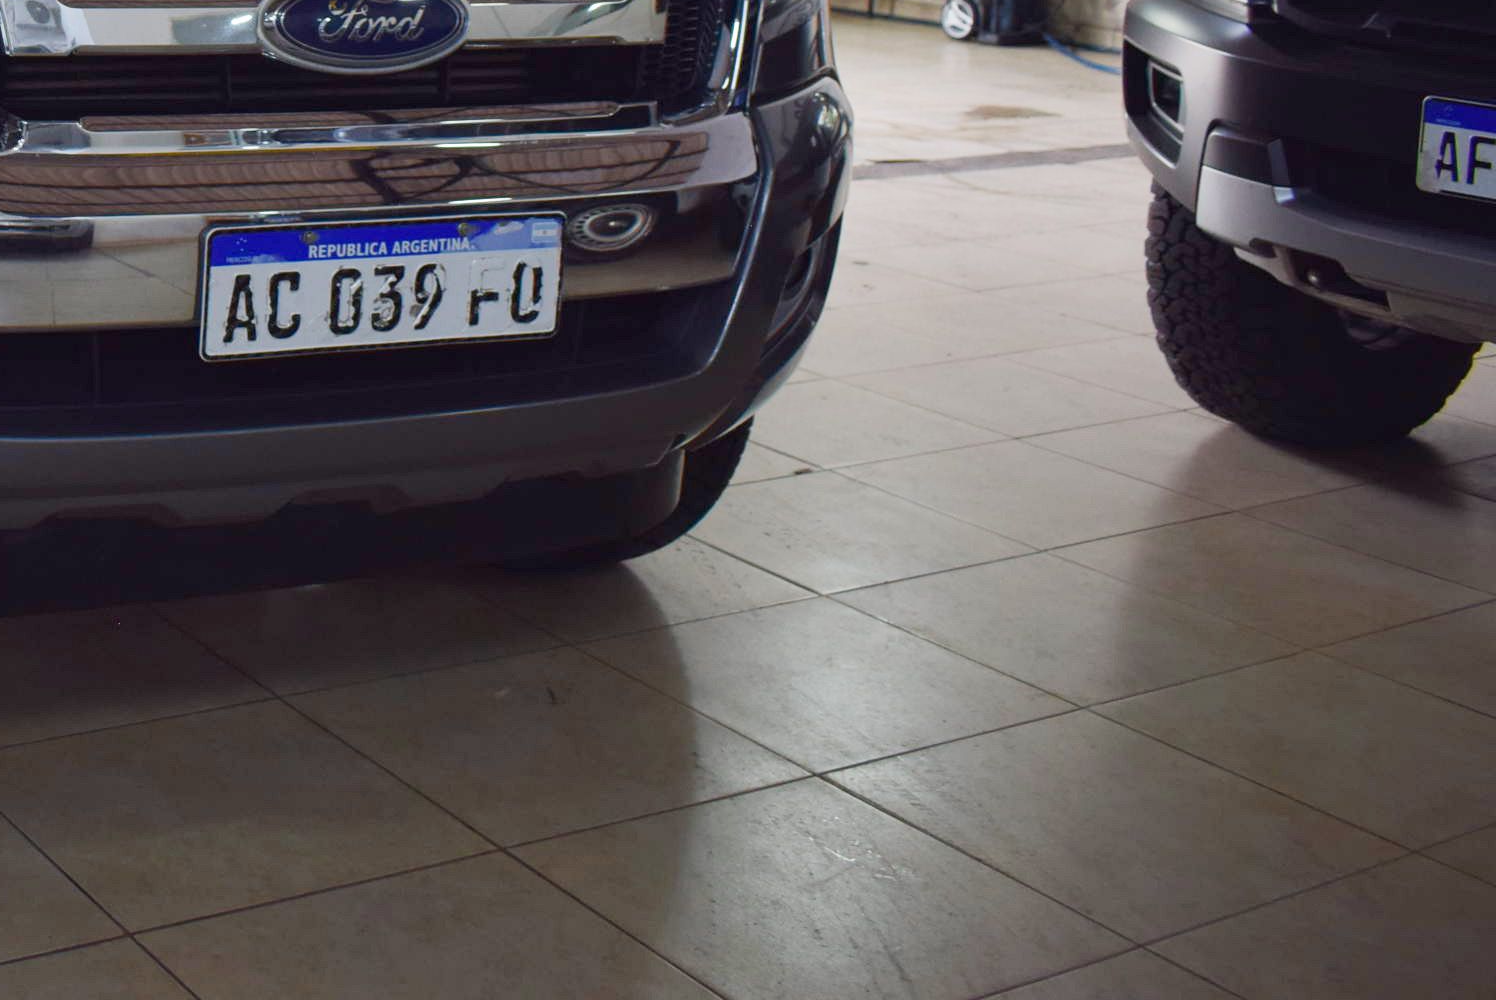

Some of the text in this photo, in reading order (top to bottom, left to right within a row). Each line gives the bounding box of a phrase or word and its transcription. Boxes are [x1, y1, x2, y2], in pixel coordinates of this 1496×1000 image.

[1435, 131, 1496, 184] AF
[308, 236, 472, 259] REPUBLICA ARGENTINA
[222, 270, 302, 343] AC
[328, 262, 444, 336] 039
